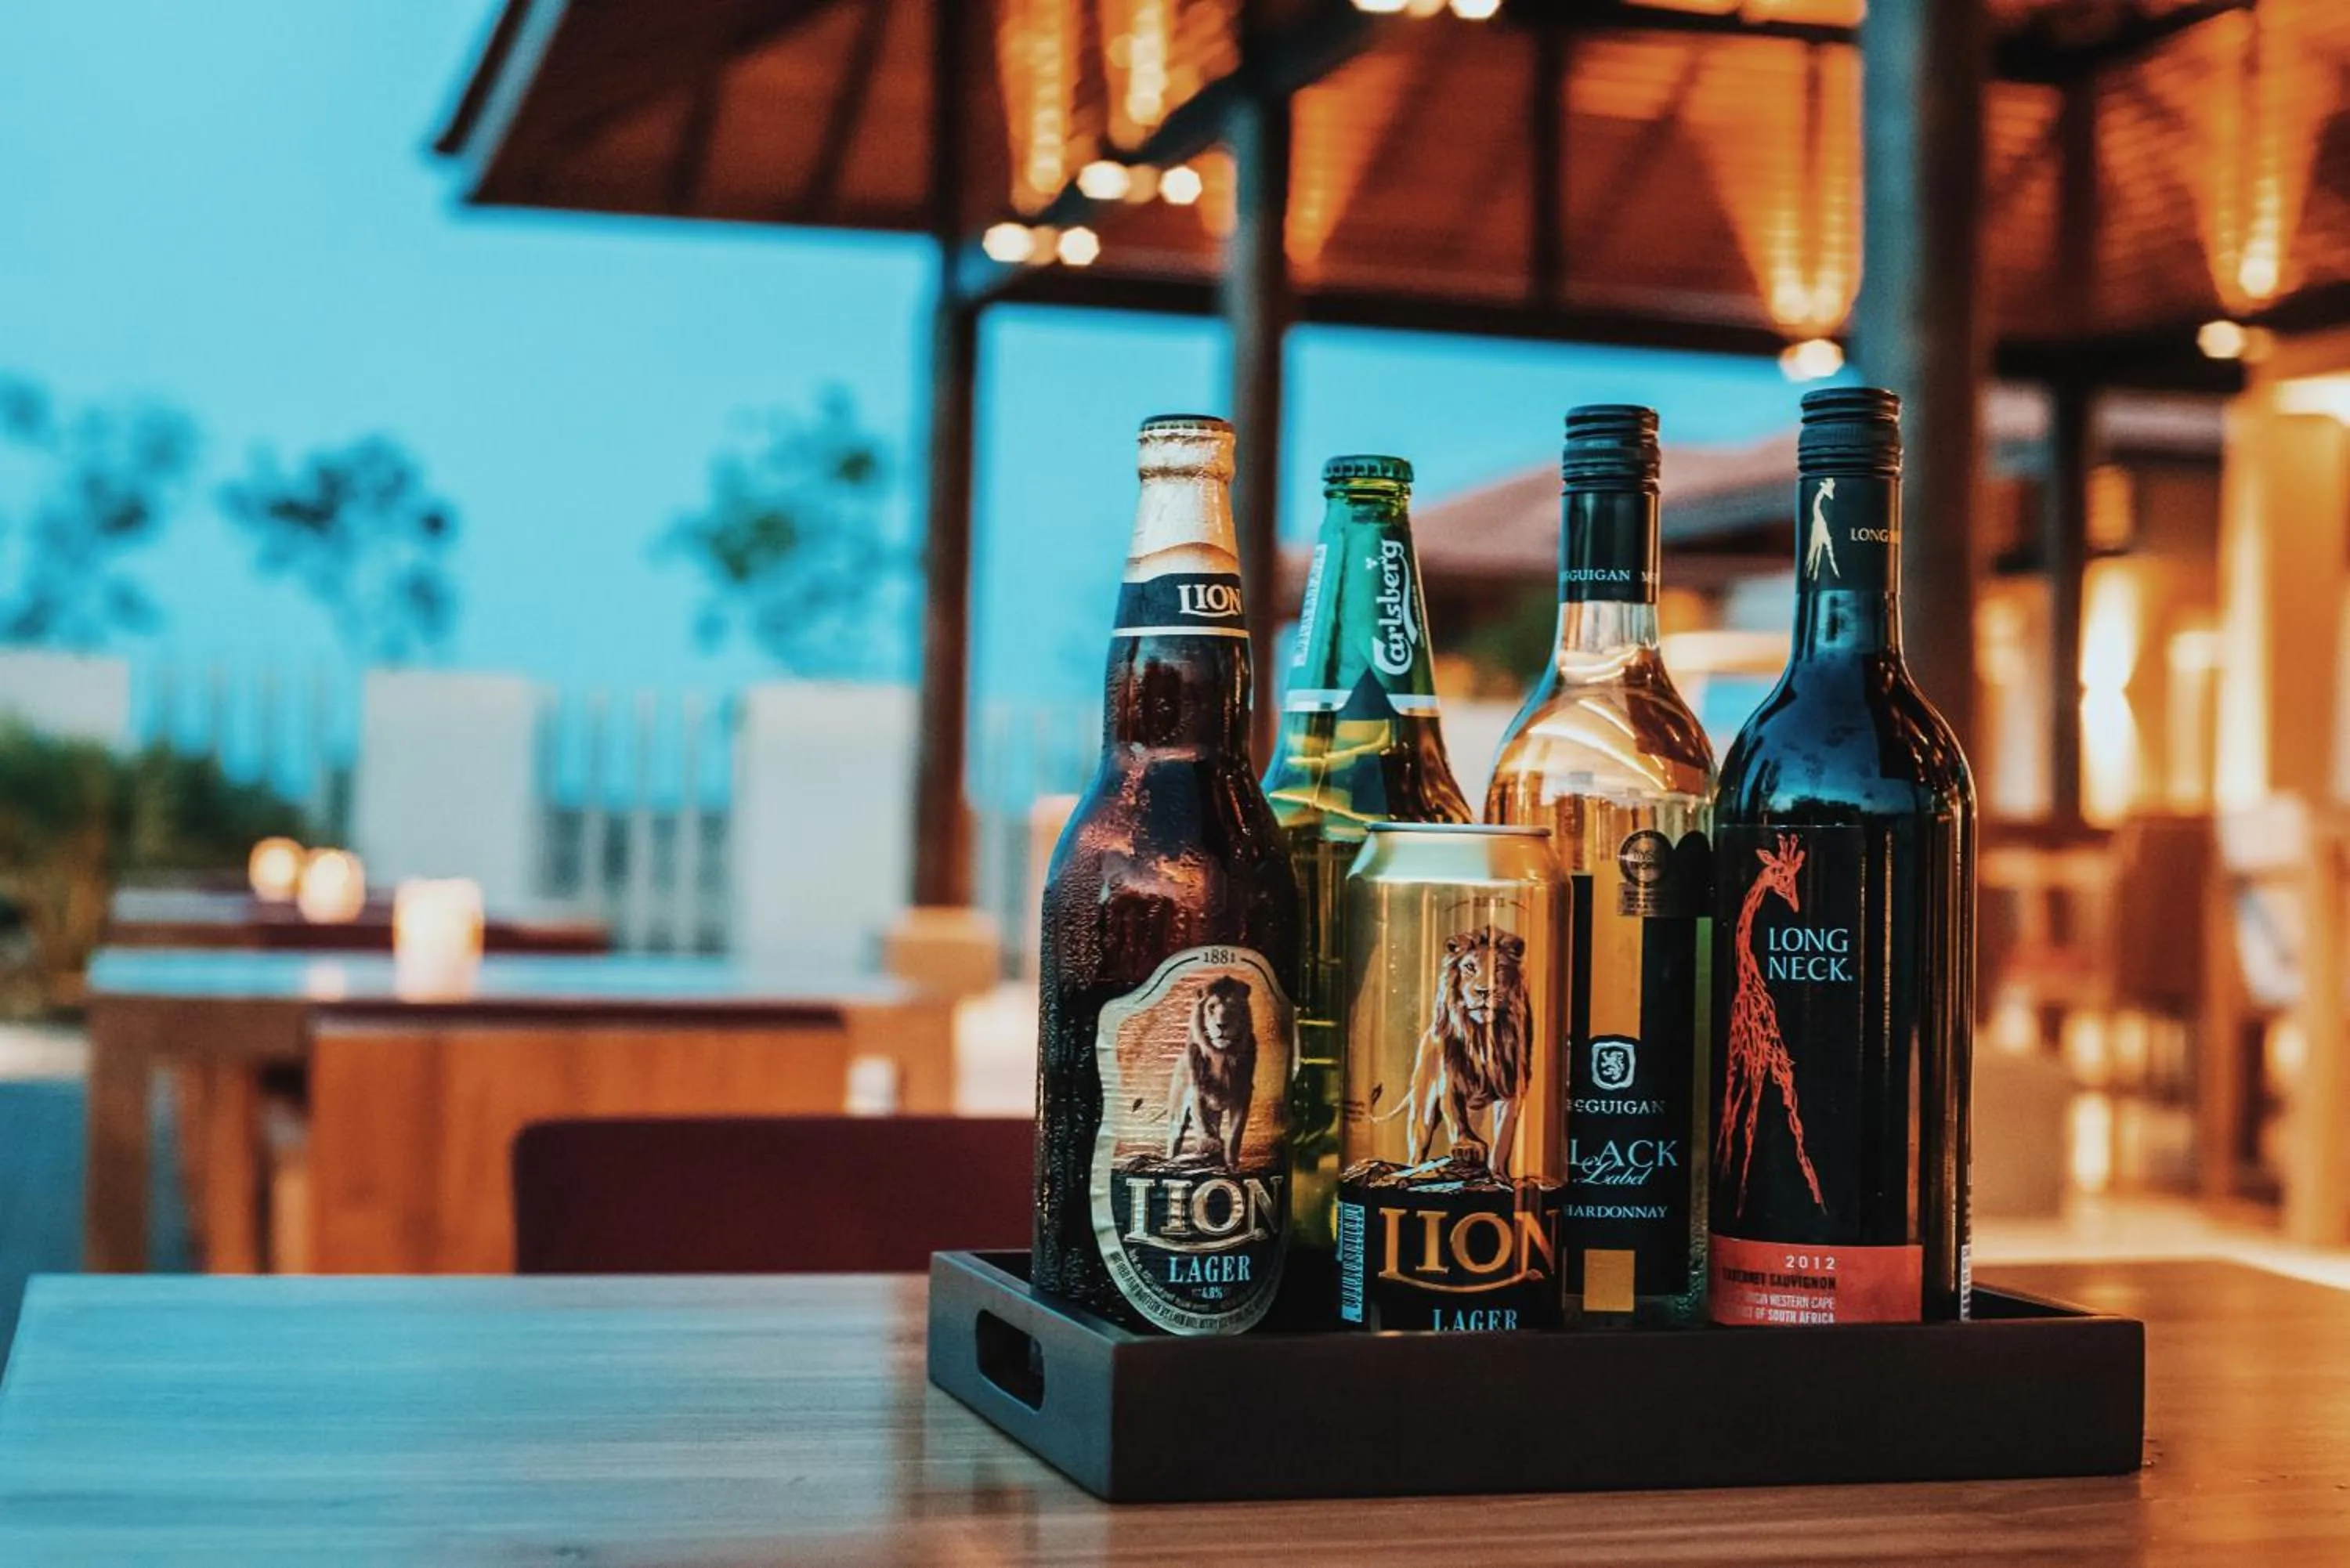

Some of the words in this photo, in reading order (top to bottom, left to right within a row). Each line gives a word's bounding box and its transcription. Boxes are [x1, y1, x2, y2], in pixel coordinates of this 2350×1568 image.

[1849, 527, 1889, 543] LONG
[1562, 569, 1630, 581] GUIGAN
[1177, 583, 1242, 619] LION
[1372, 539, 1419, 676] Carlsberg
[1769, 927, 1848, 953] LONG
[1203, 948, 1235, 964] 1881
[1568, 1139, 1678, 1168] LACK
[1573, 1155, 1653, 1184] Label
[1123, 1177, 1284, 1252] LION
[1564, 1205, 1668, 1219] HARDONNAY
[1378, 1207, 1560, 1293] LION
[1169, 1255, 1251, 1283] LAGER
[1785, 1255, 1835, 1270] 2012
[1770, 1294, 1809, 1307] WESTERN
[1811, 1297, 1835, 1310] CAPE
[1433, 1309, 1518, 1331] LAGER
[1768, 1310, 1797, 1323] SOUTH
[1799, 1311, 1835, 1324] AFRICA
